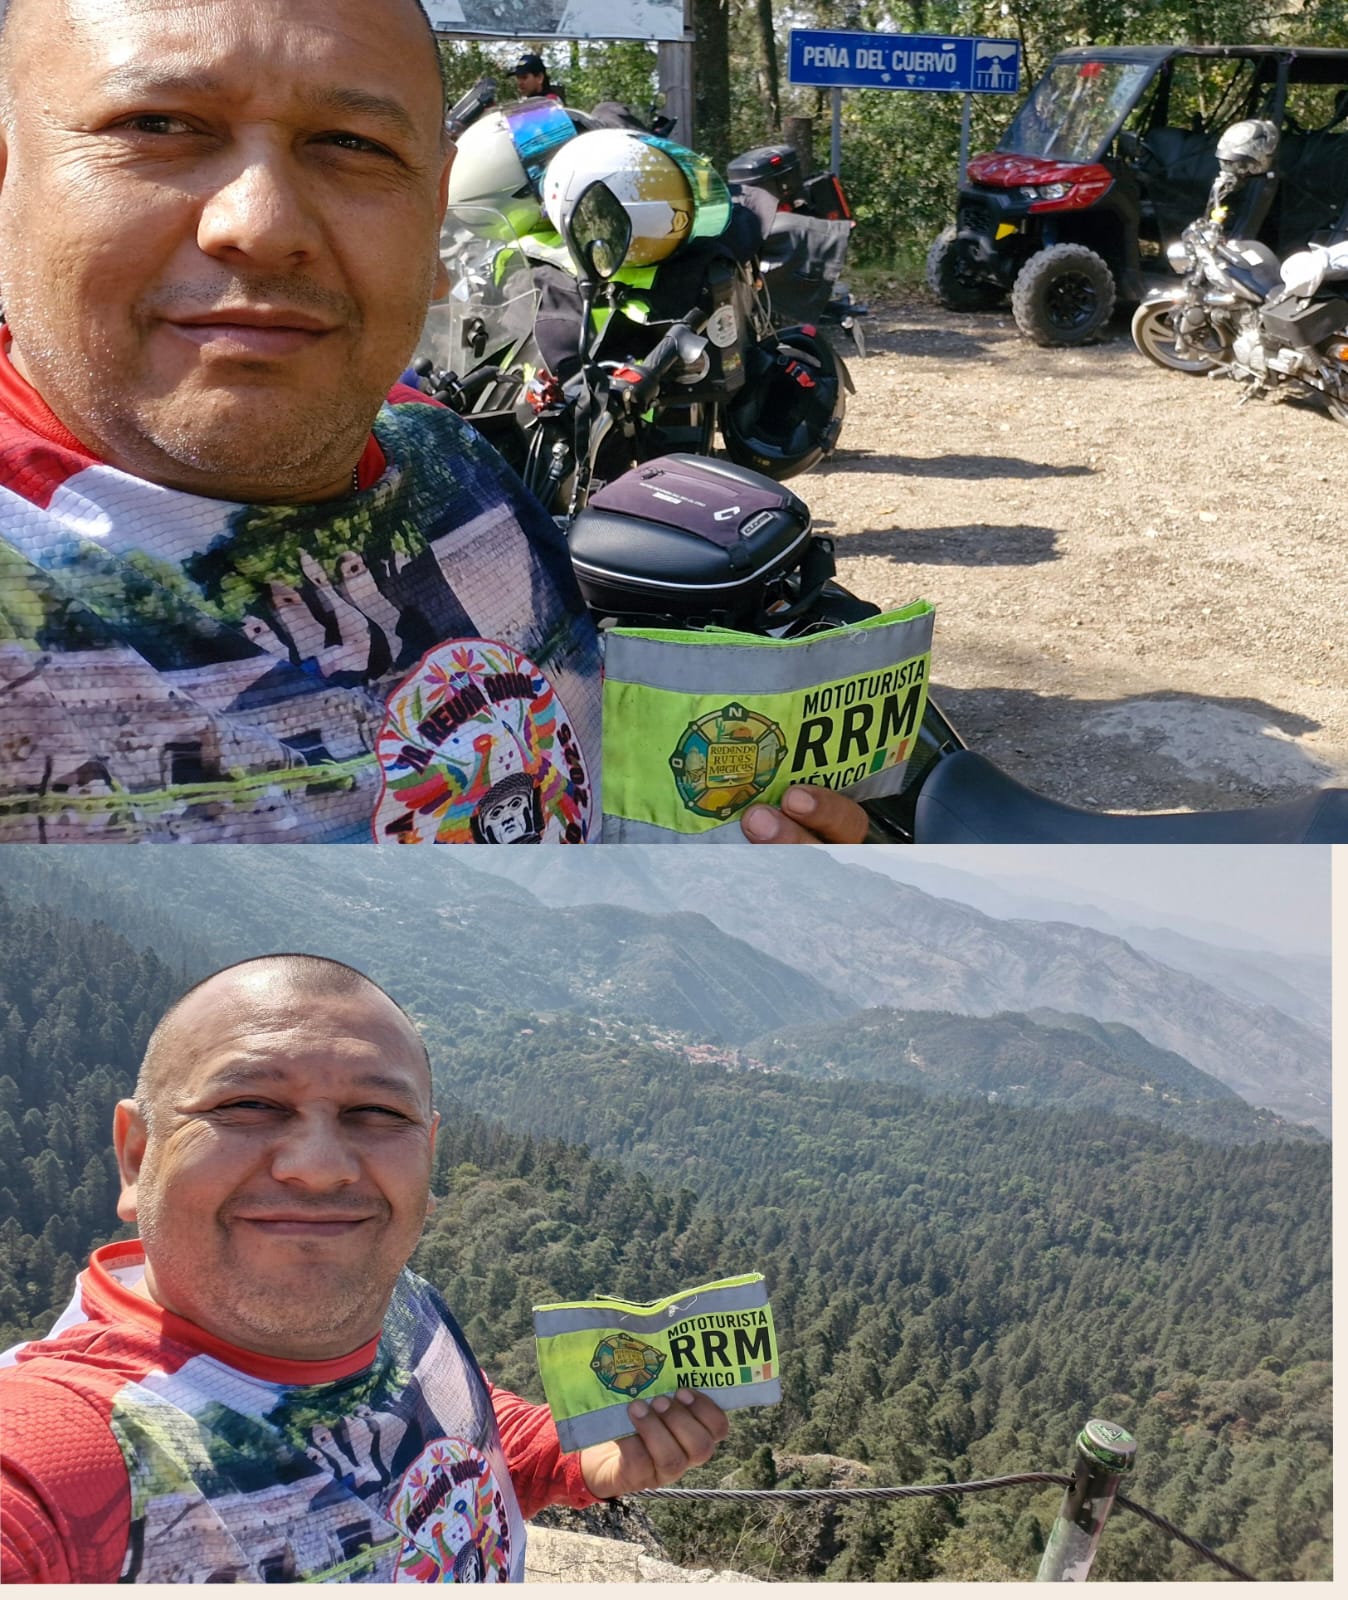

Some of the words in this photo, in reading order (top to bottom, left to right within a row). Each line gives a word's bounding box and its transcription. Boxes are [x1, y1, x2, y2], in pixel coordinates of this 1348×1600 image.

[803, 43, 850, 69] PEÑA
[855, 49, 886, 70] DEL
[891, 50, 957, 74] CUERVO
[802, 659, 925, 719] MOTOTURISTA
[791, 683, 922, 773] RRM
[667, 1310, 769, 1339] MOTOTURISTA
[669, 1326, 772, 1369] RRM
[676, 1369, 735, 1389] MÉXICO
